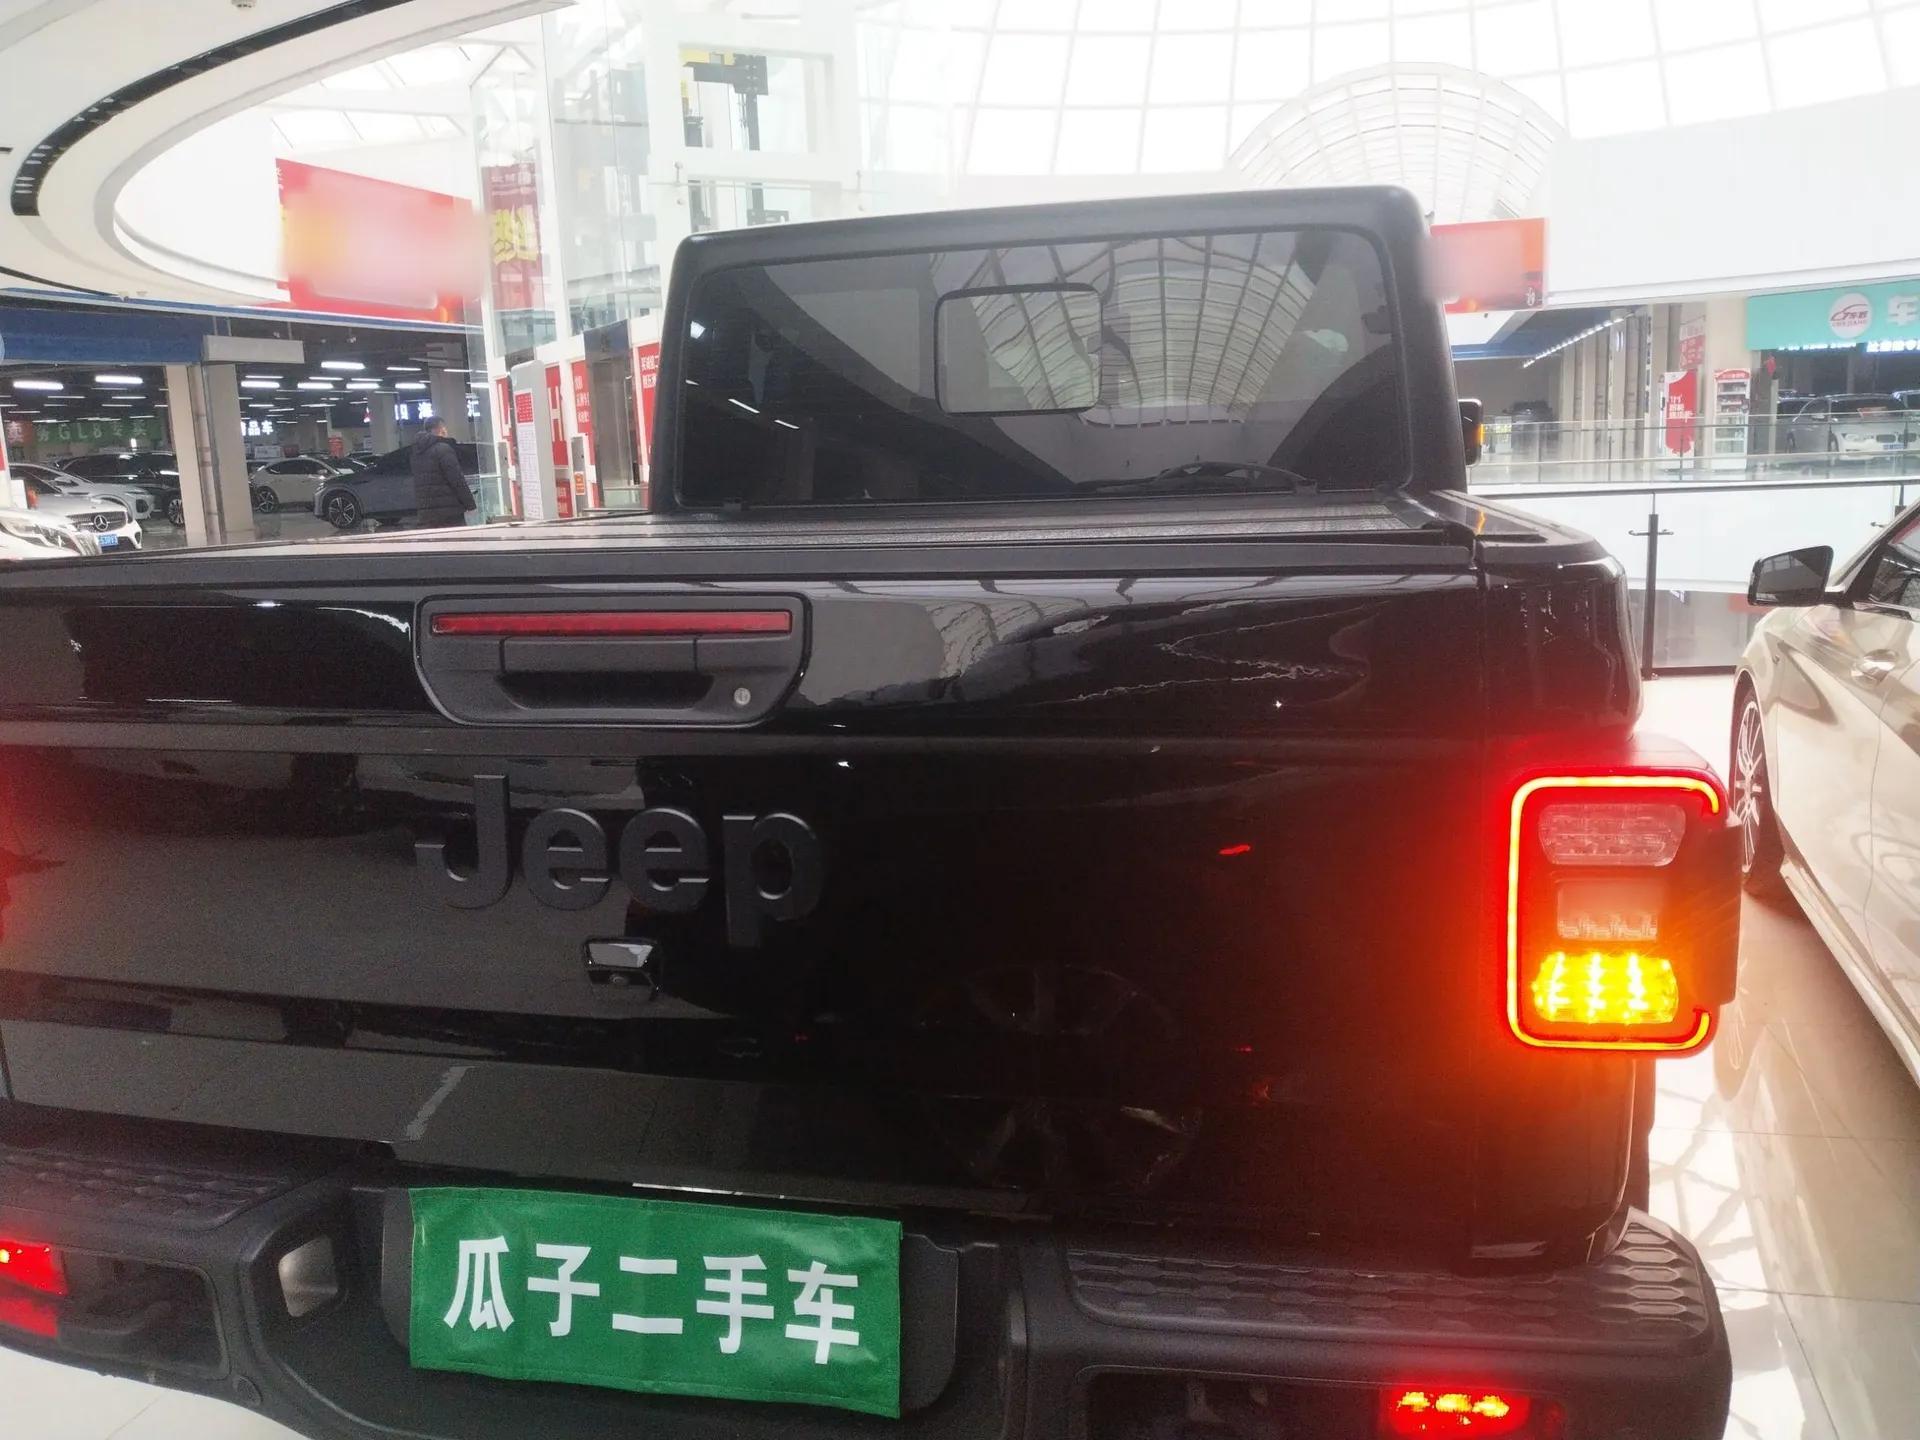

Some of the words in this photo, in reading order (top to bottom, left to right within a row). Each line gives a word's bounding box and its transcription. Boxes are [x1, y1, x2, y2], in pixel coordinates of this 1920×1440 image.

[414, 774, 825, 948] Jeep
[443, 1235, 861, 1365] 瓜子二手车
